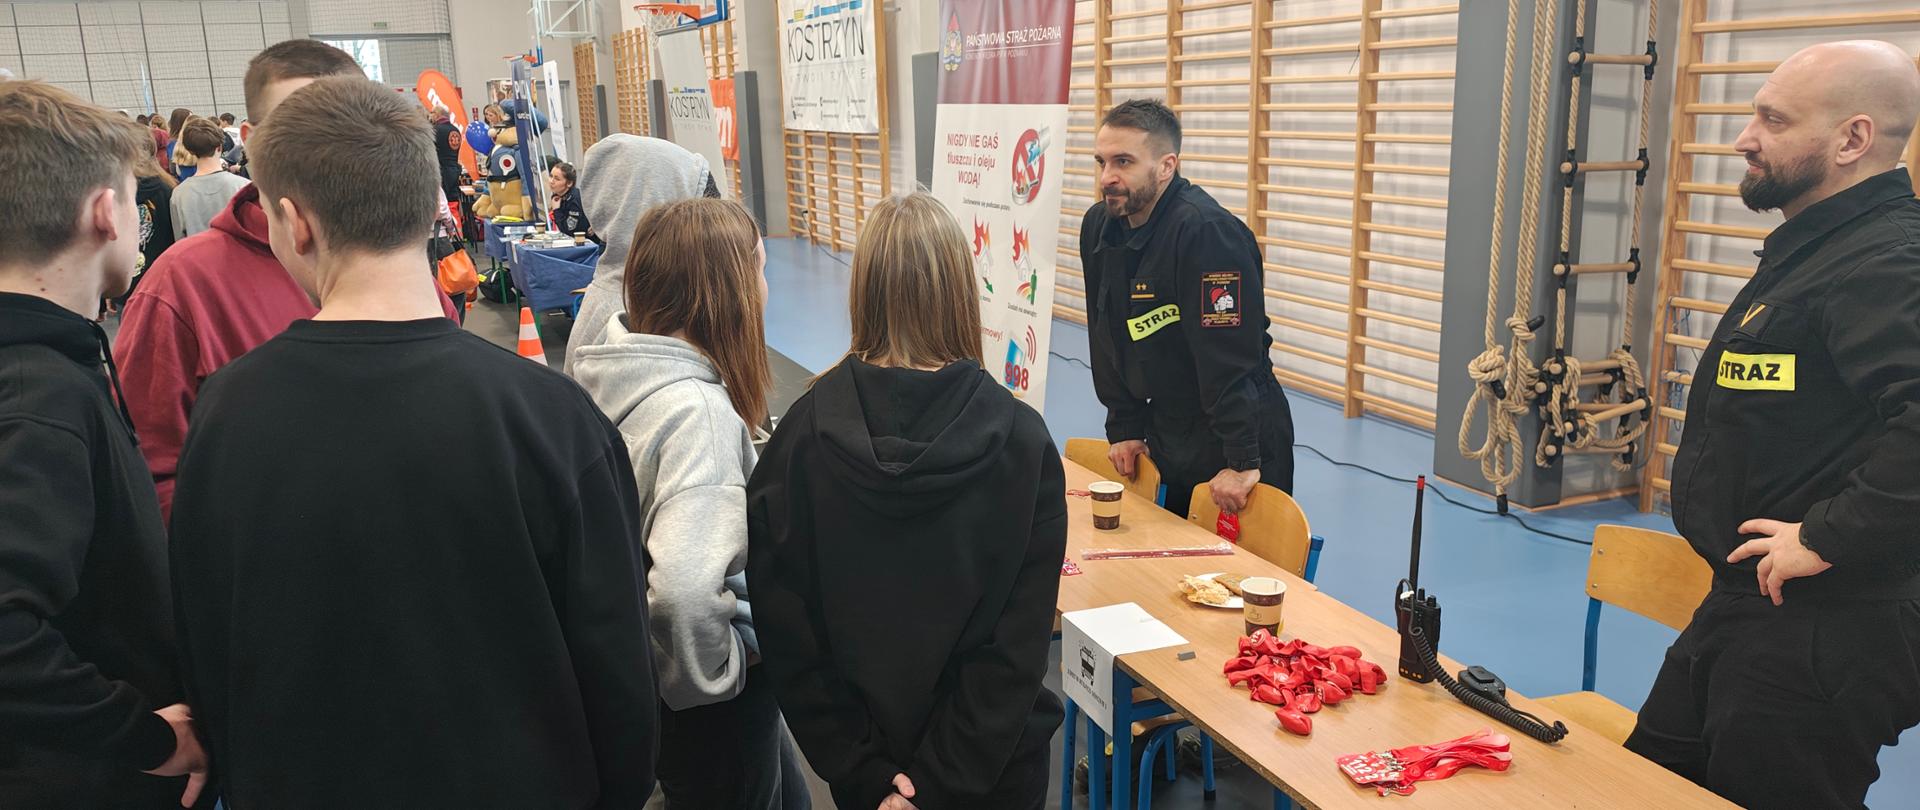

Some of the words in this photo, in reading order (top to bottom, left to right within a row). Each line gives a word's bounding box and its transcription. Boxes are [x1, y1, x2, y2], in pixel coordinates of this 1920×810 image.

[787, 16, 865, 64] KOSTRZYN
[966, 31, 1005, 47] PAŃSTWOWA
[1006, 26, 1028, 44] STRAŻ
[670, 96, 710, 120] KOSTRZYN
[946, 132, 968, 147] NIGDY
[969, 134, 980, 148] NIE
[982, 132, 999, 149] GAŚ
[977, 153, 996, 171] oleju
[1005, 361, 1029, 391] 998
